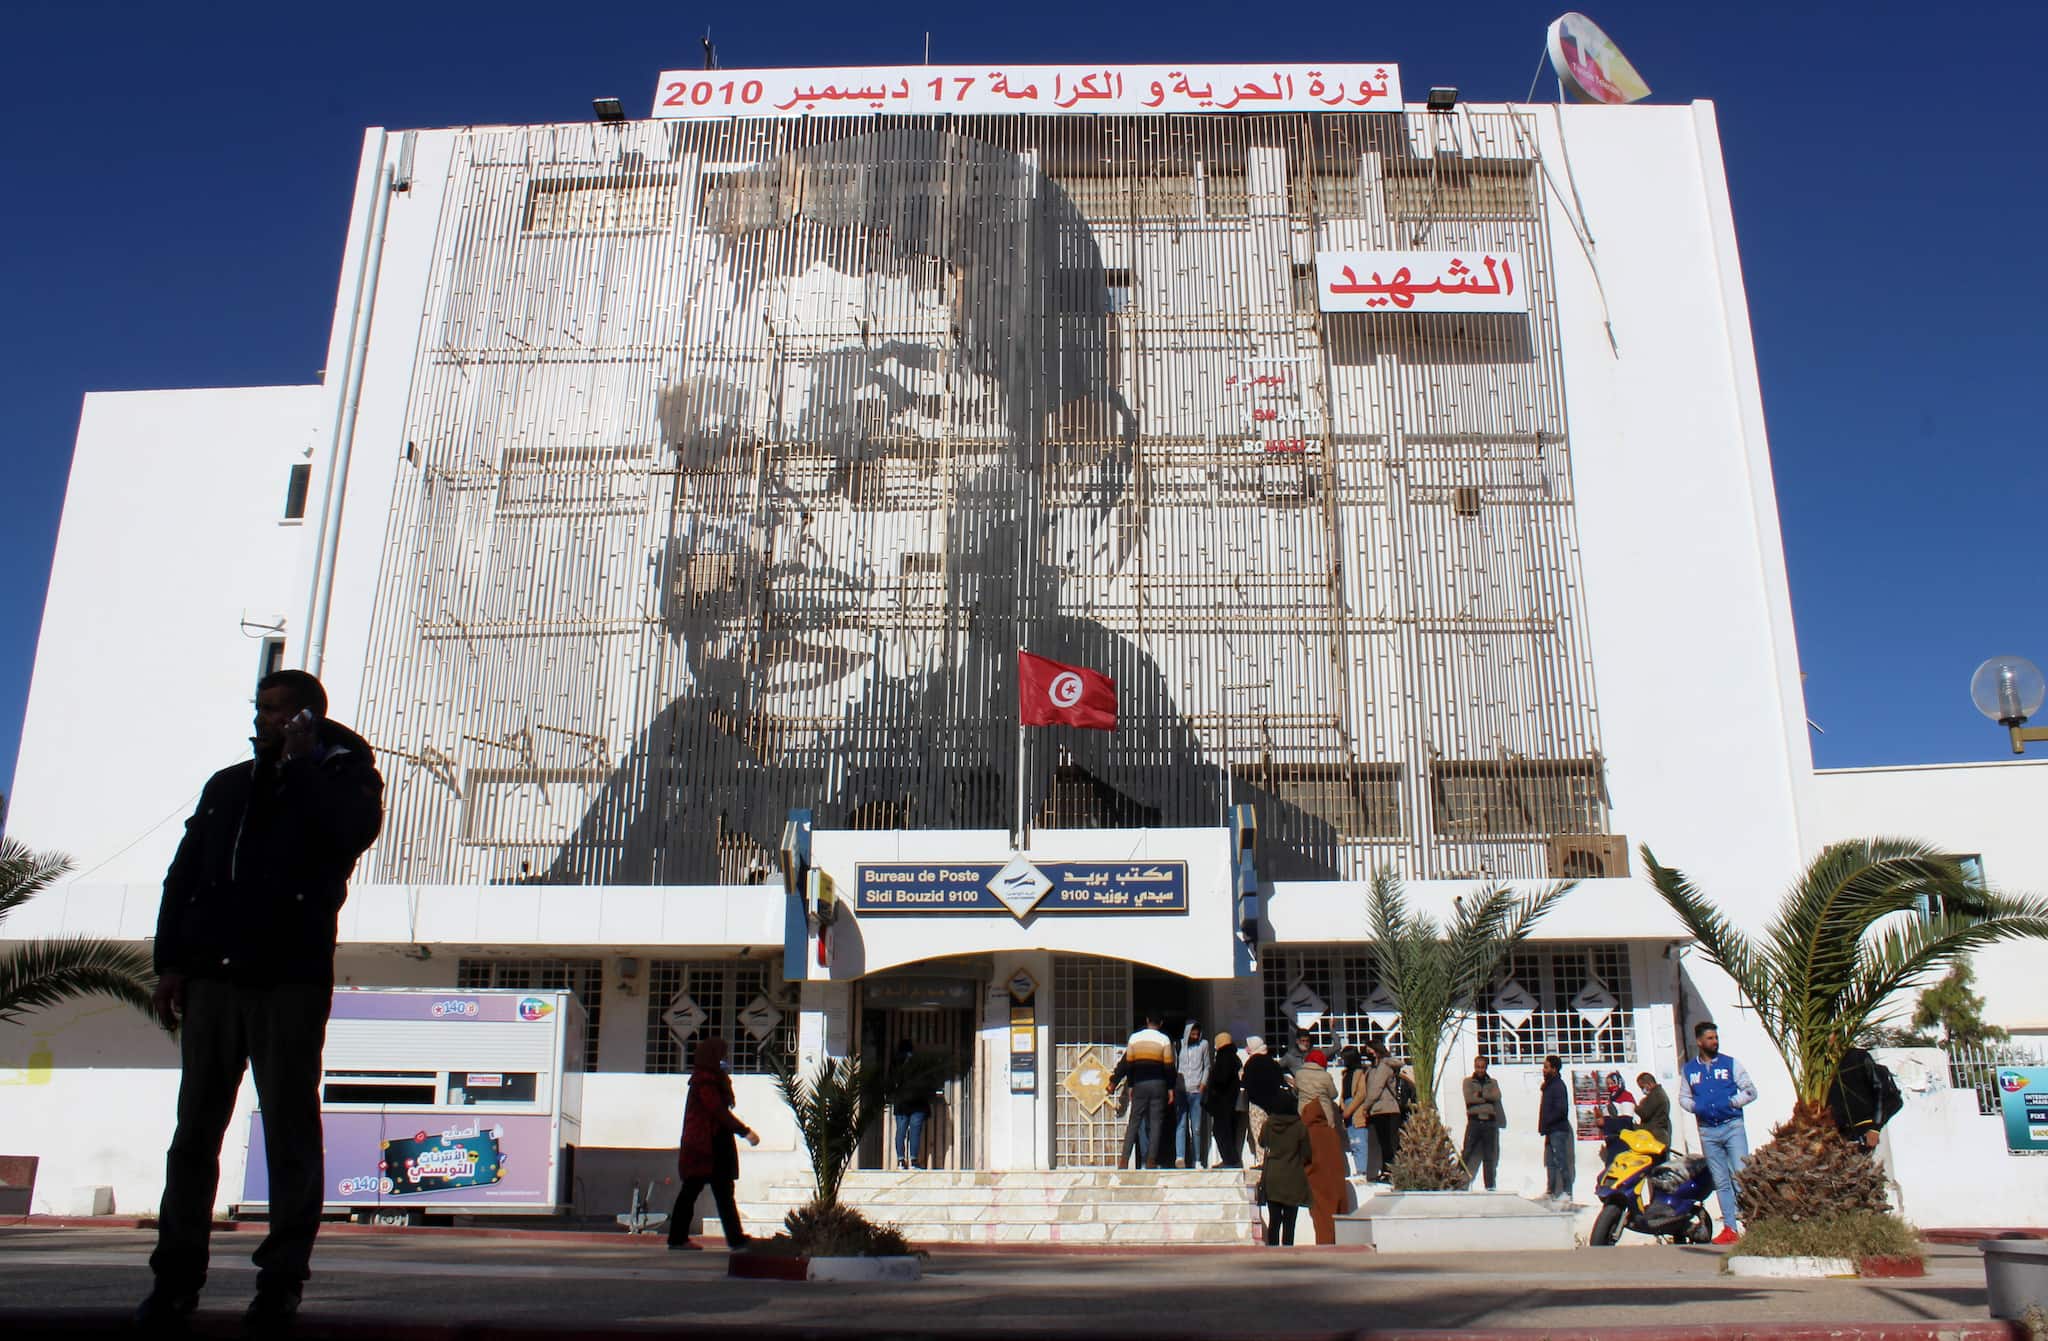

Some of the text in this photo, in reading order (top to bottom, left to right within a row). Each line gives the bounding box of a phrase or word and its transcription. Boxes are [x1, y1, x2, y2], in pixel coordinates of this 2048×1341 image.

[662, 80, 764, 107] 2010
[773, 77, 909, 111] ديسمبر
[927, 78, 976, 101] 17
[1309, 69, 1388, 107] ثورة
[1330, 255, 1514, 309] الشهيد
[865, 870, 979, 883] Bureau de Poste
[1063, 867, 1173, 886] مكتب بريد
[866, 889, 978, 903] Sidi Bouzid 9100
[1061, 889, 1173, 907] سيدي بوزيد 9100
